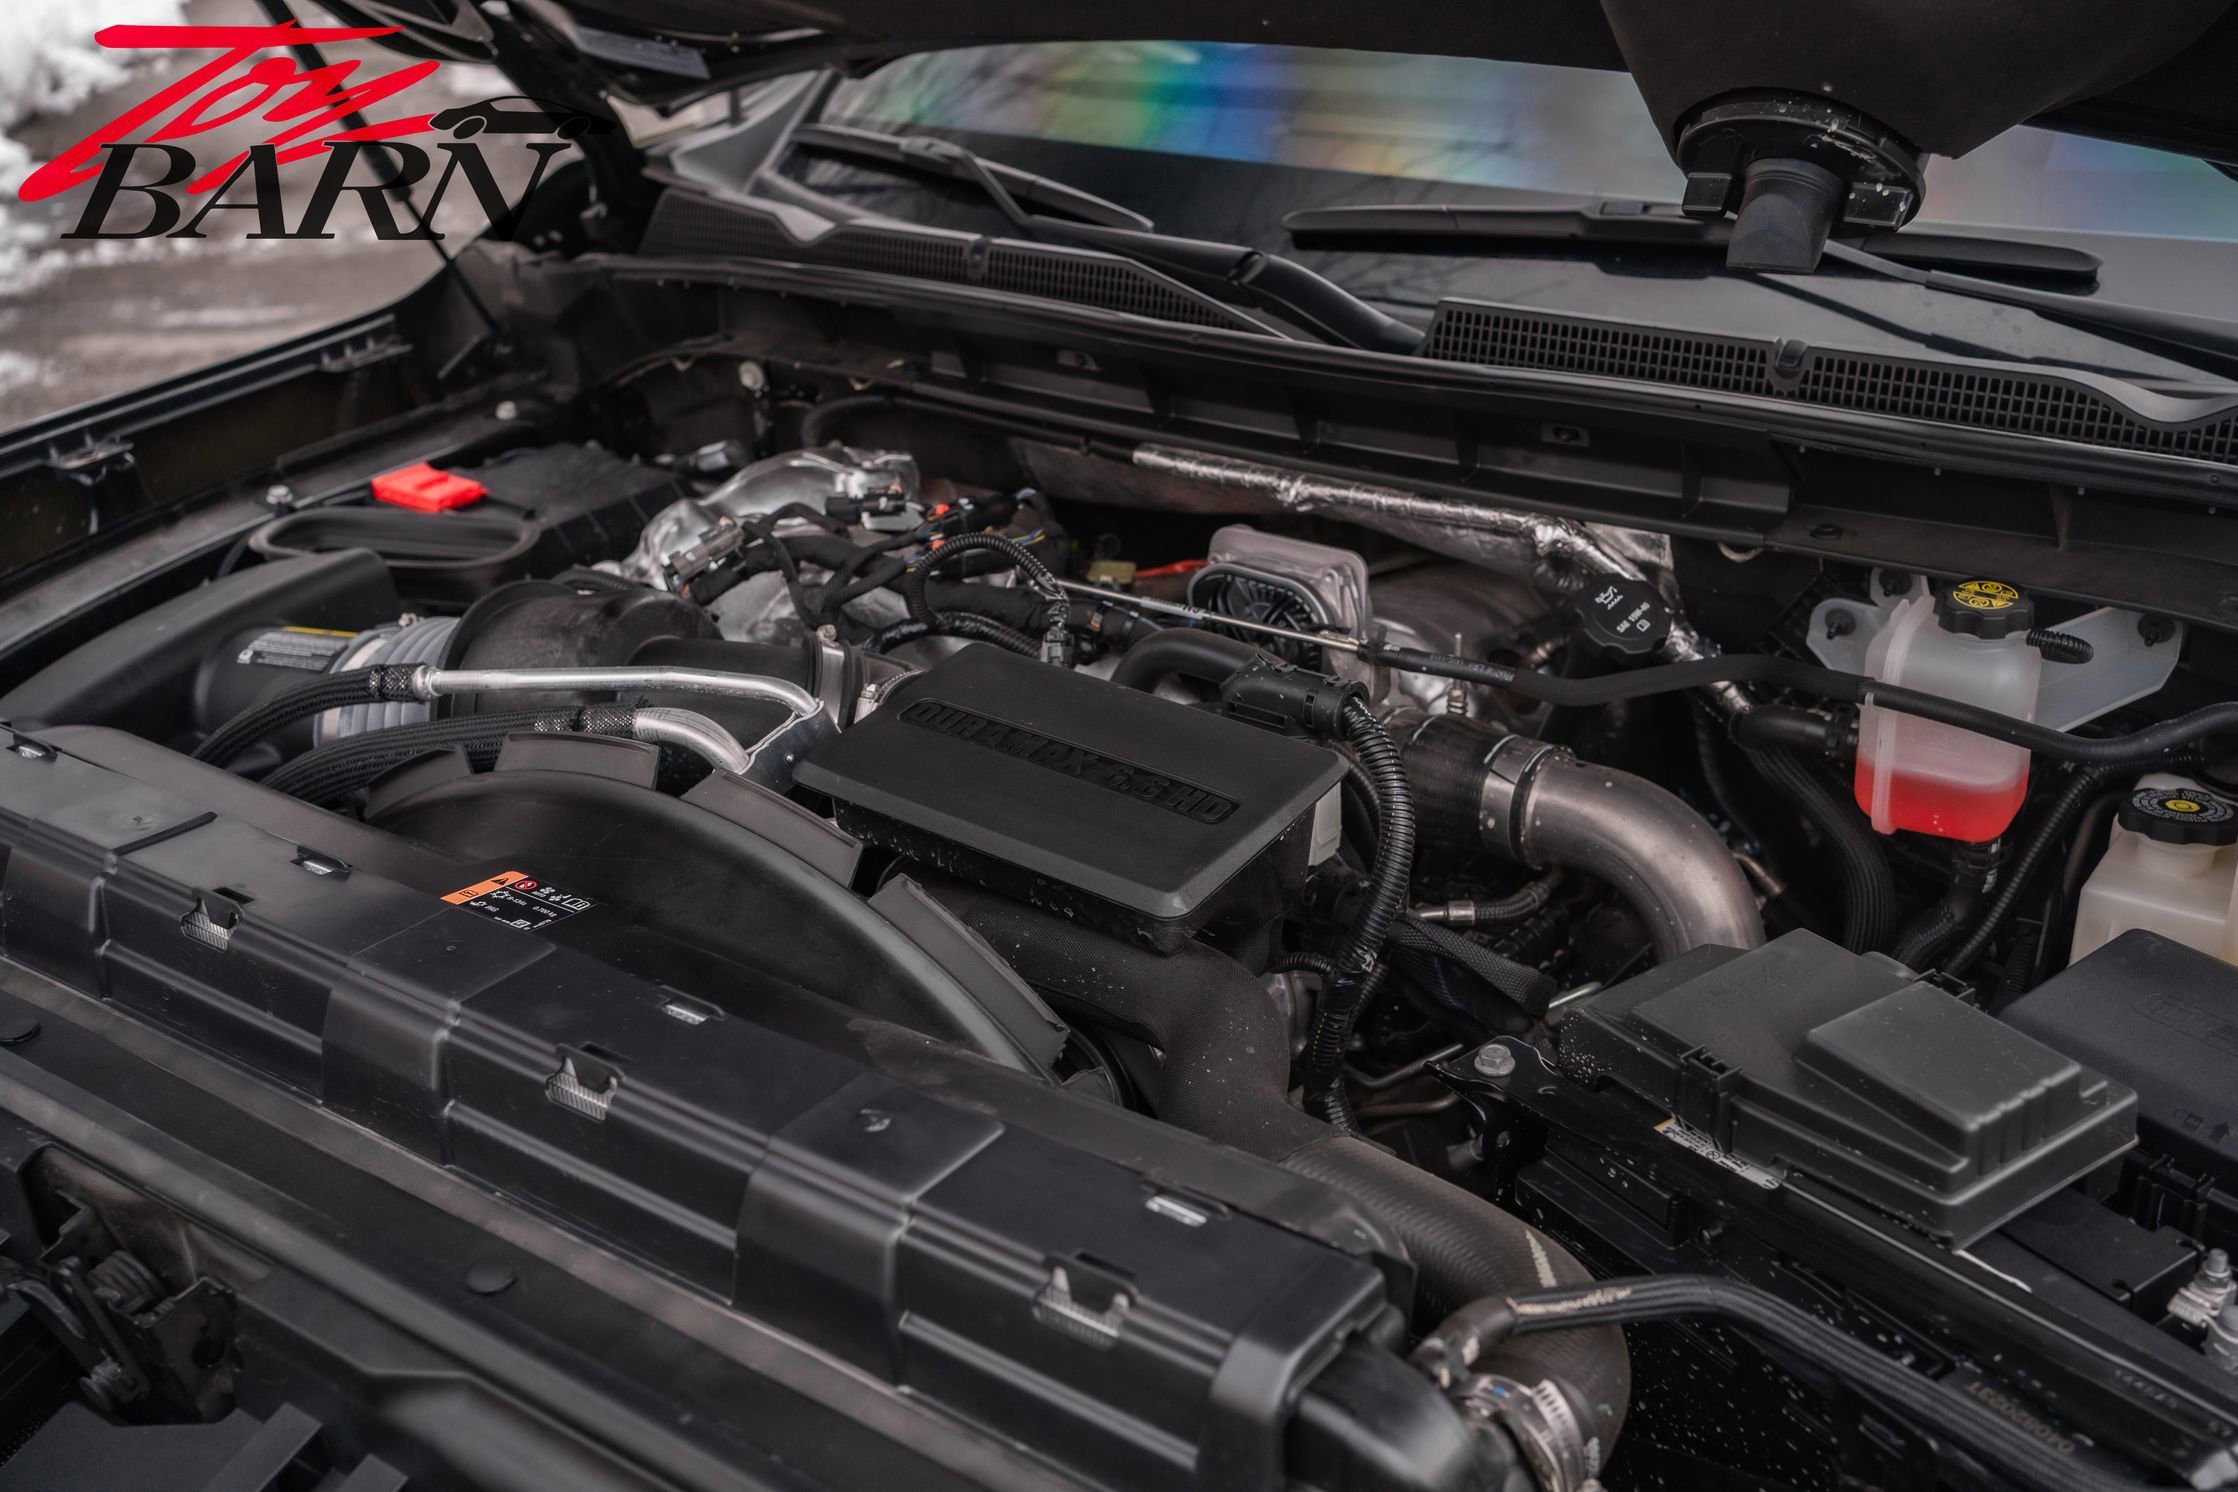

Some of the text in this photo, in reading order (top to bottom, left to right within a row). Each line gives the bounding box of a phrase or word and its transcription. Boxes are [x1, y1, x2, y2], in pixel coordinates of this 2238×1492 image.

[910, 702, 1234, 824] DURAMAX 6.6 HD
